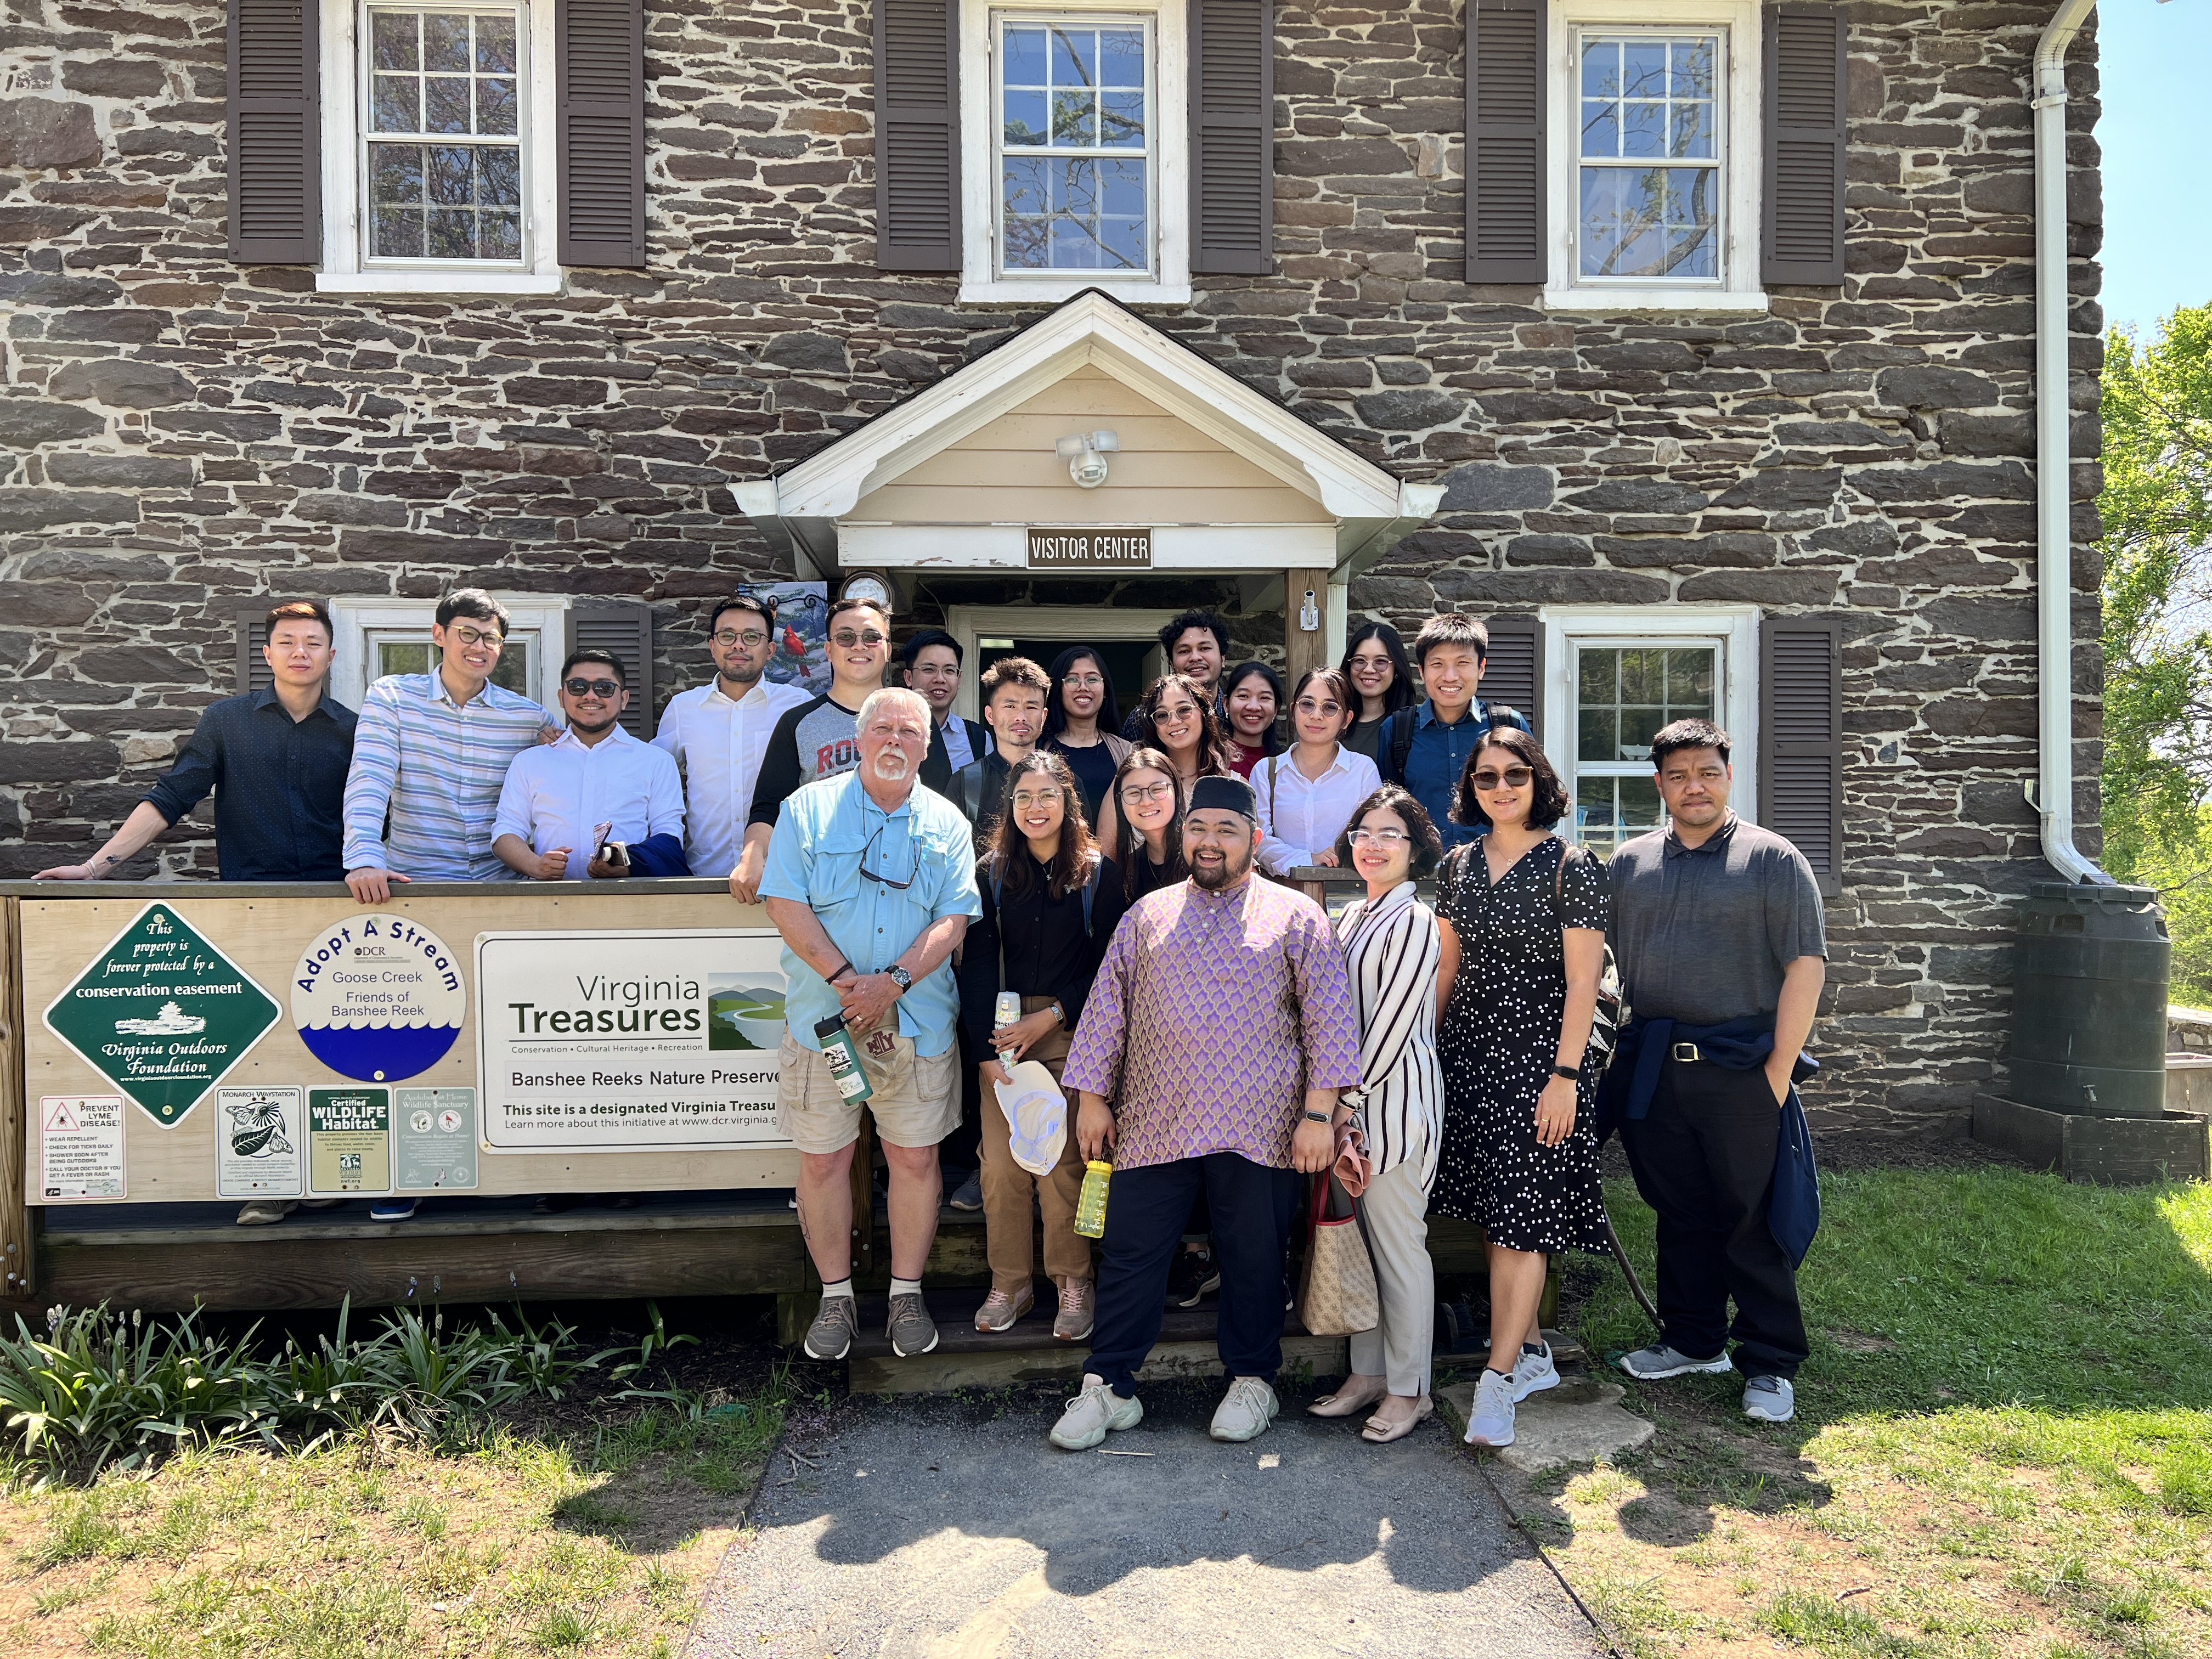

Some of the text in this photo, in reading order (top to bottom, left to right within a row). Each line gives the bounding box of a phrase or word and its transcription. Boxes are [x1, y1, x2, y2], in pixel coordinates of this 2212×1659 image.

[1031, 537, 1148, 559] VISITOR CENTER
[146, 920, 172, 934] This
[132, 939, 188, 957] property is
[363, 947, 386, 956] DCR
[297, 920, 458, 992] Adopt A Stream
[103, 955, 214, 978] forever protected by a
[332, 972, 422, 983] Goose Creek
[76, 982, 242, 998] conservation easement
[347, 991, 409, 1002] Friends of
[576, 974, 699, 1007] Virginia
[332, 1006, 424, 1016] Banshee Reek
[509, 1003, 701, 1033] Treasures
[101, 1037, 227, 1061] Virginia Outdoors
[613, 1045, 648, 1053] Heritage
[127, 1057, 206, 1074] Foundation
[512, 1072, 585, 1086] Banshee
[592, 1071, 643, 1086] Reeks
[650, 1070, 705, 1085] Nature
[312, 1106, 386, 1119] WILDLIFE
[503, 1105, 532, 1115] This
[536, 1104, 561, 1115] site
[565, 1104, 575, 1114] is
[590, 1102, 667, 1116] designated
[671, 1102, 726, 1114] Virginia
[322, 1118, 377, 1130] Habitat
[505, 1120, 533, 1128] Learn
[567, 1120, 597, 1128] about
[601, 1118, 619, 1127] this
[623, 1117, 666, 1126] initiative
